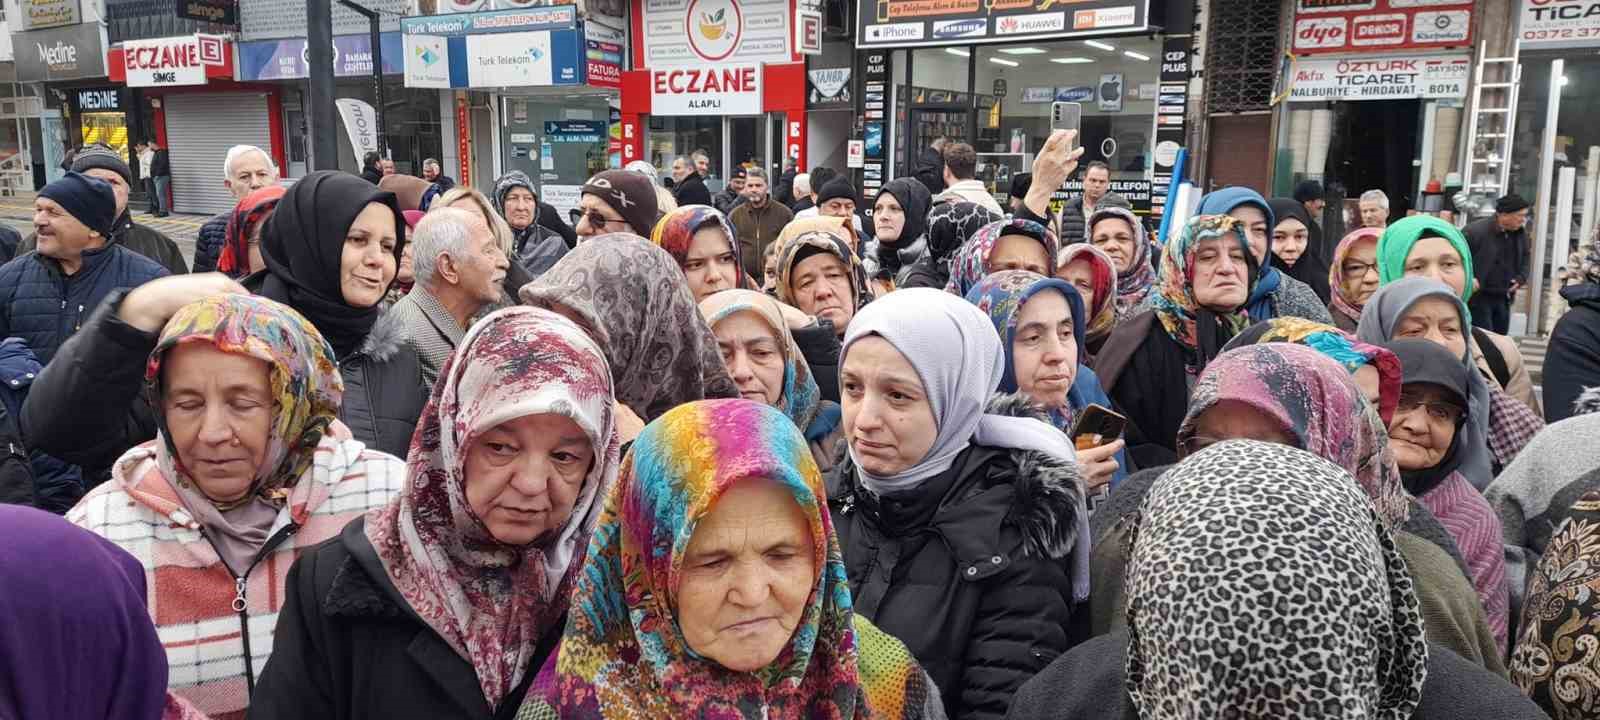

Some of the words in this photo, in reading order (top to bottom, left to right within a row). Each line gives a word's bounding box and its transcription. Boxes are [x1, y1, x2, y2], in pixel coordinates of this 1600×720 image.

[427, 21, 464, 33] Telekom
[1020, 18, 1062, 30] HUAWEI
[1358, 23, 1400, 36] DEKOR
[882, 25, 916, 38] iPhone
[1300, 23, 1343, 44] dyo
[1524, 28, 1573, 40] 0372
[1578, 27, 1600, 37] 37
[35, 40, 77, 65] Medine
[204, 41, 217, 58] E
[125, 43, 200, 70] ECZANE
[497, 54, 530, 65] Telekom
[868, 55, 883, 64] CEP
[1165, 51, 1186, 62] CEP
[588, 63, 620, 77] FATURA
[867, 64, 885, 73] PLUS
[1163, 62, 1187, 73] PLUS
[1336, 58, 1418, 74] ÖZTÜRK
[654, 67, 756, 94] ECZANE
[1295, 69, 1325, 82] Akfix
[1361, 85, 1416, 96] HIRDAVAT
[1429, 83, 1460, 94] BOYA
[688, 99, 721, 108] ALAPLI
[1108, 182, 1150, 191] TELEFON
